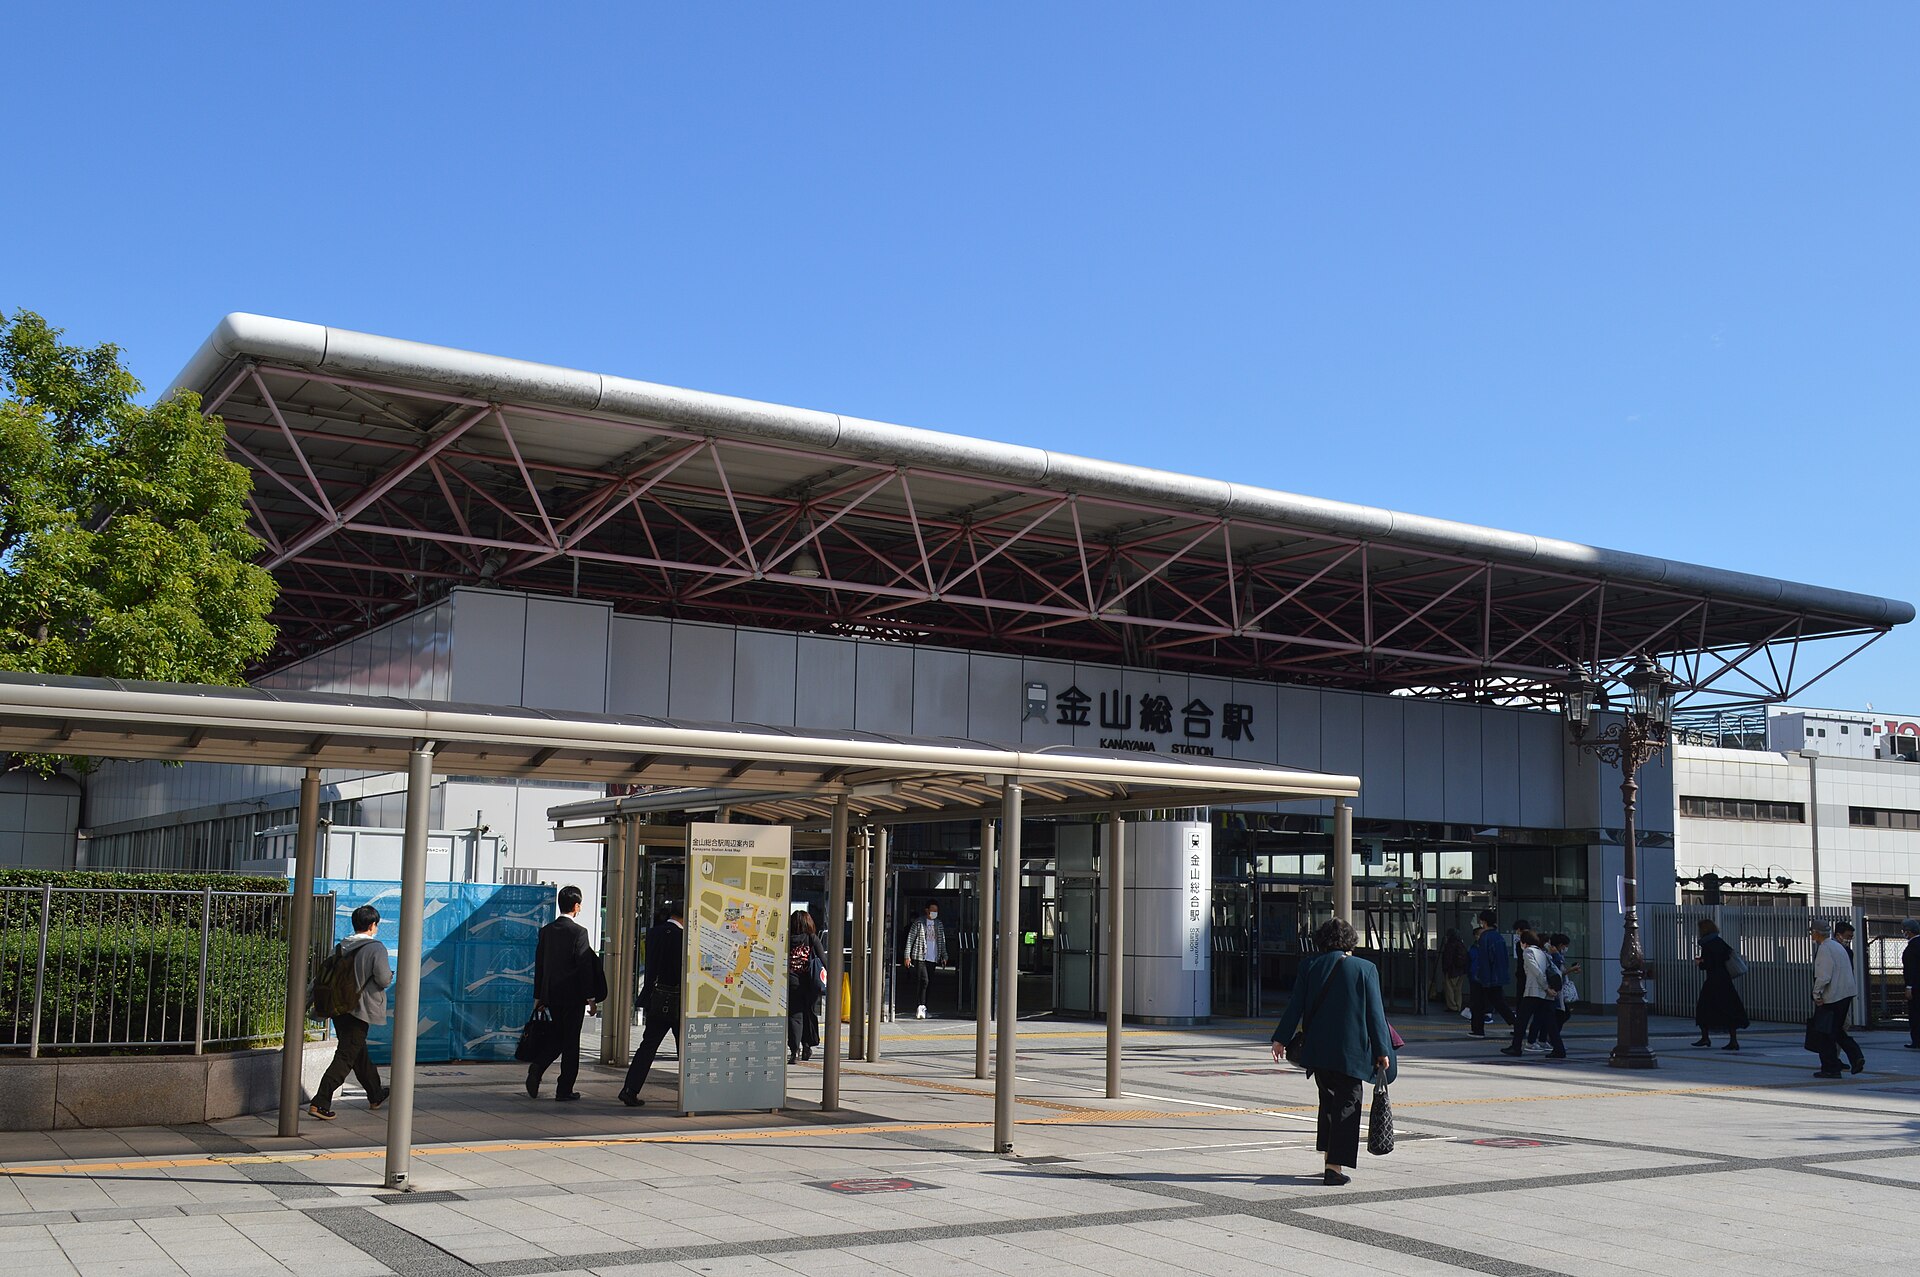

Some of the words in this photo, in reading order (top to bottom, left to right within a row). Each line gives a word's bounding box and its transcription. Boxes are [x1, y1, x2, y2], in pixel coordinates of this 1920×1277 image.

[1056, 685, 1255, 741] 金山総合駅
[1100, 738, 1155, 752] KANAYAMA
[1171, 743, 1214, 756] STATION
[692, 838, 755, 848] 金山総合駅周辺案内図
[1190, 854, 1200, 922] 金山総合駅
